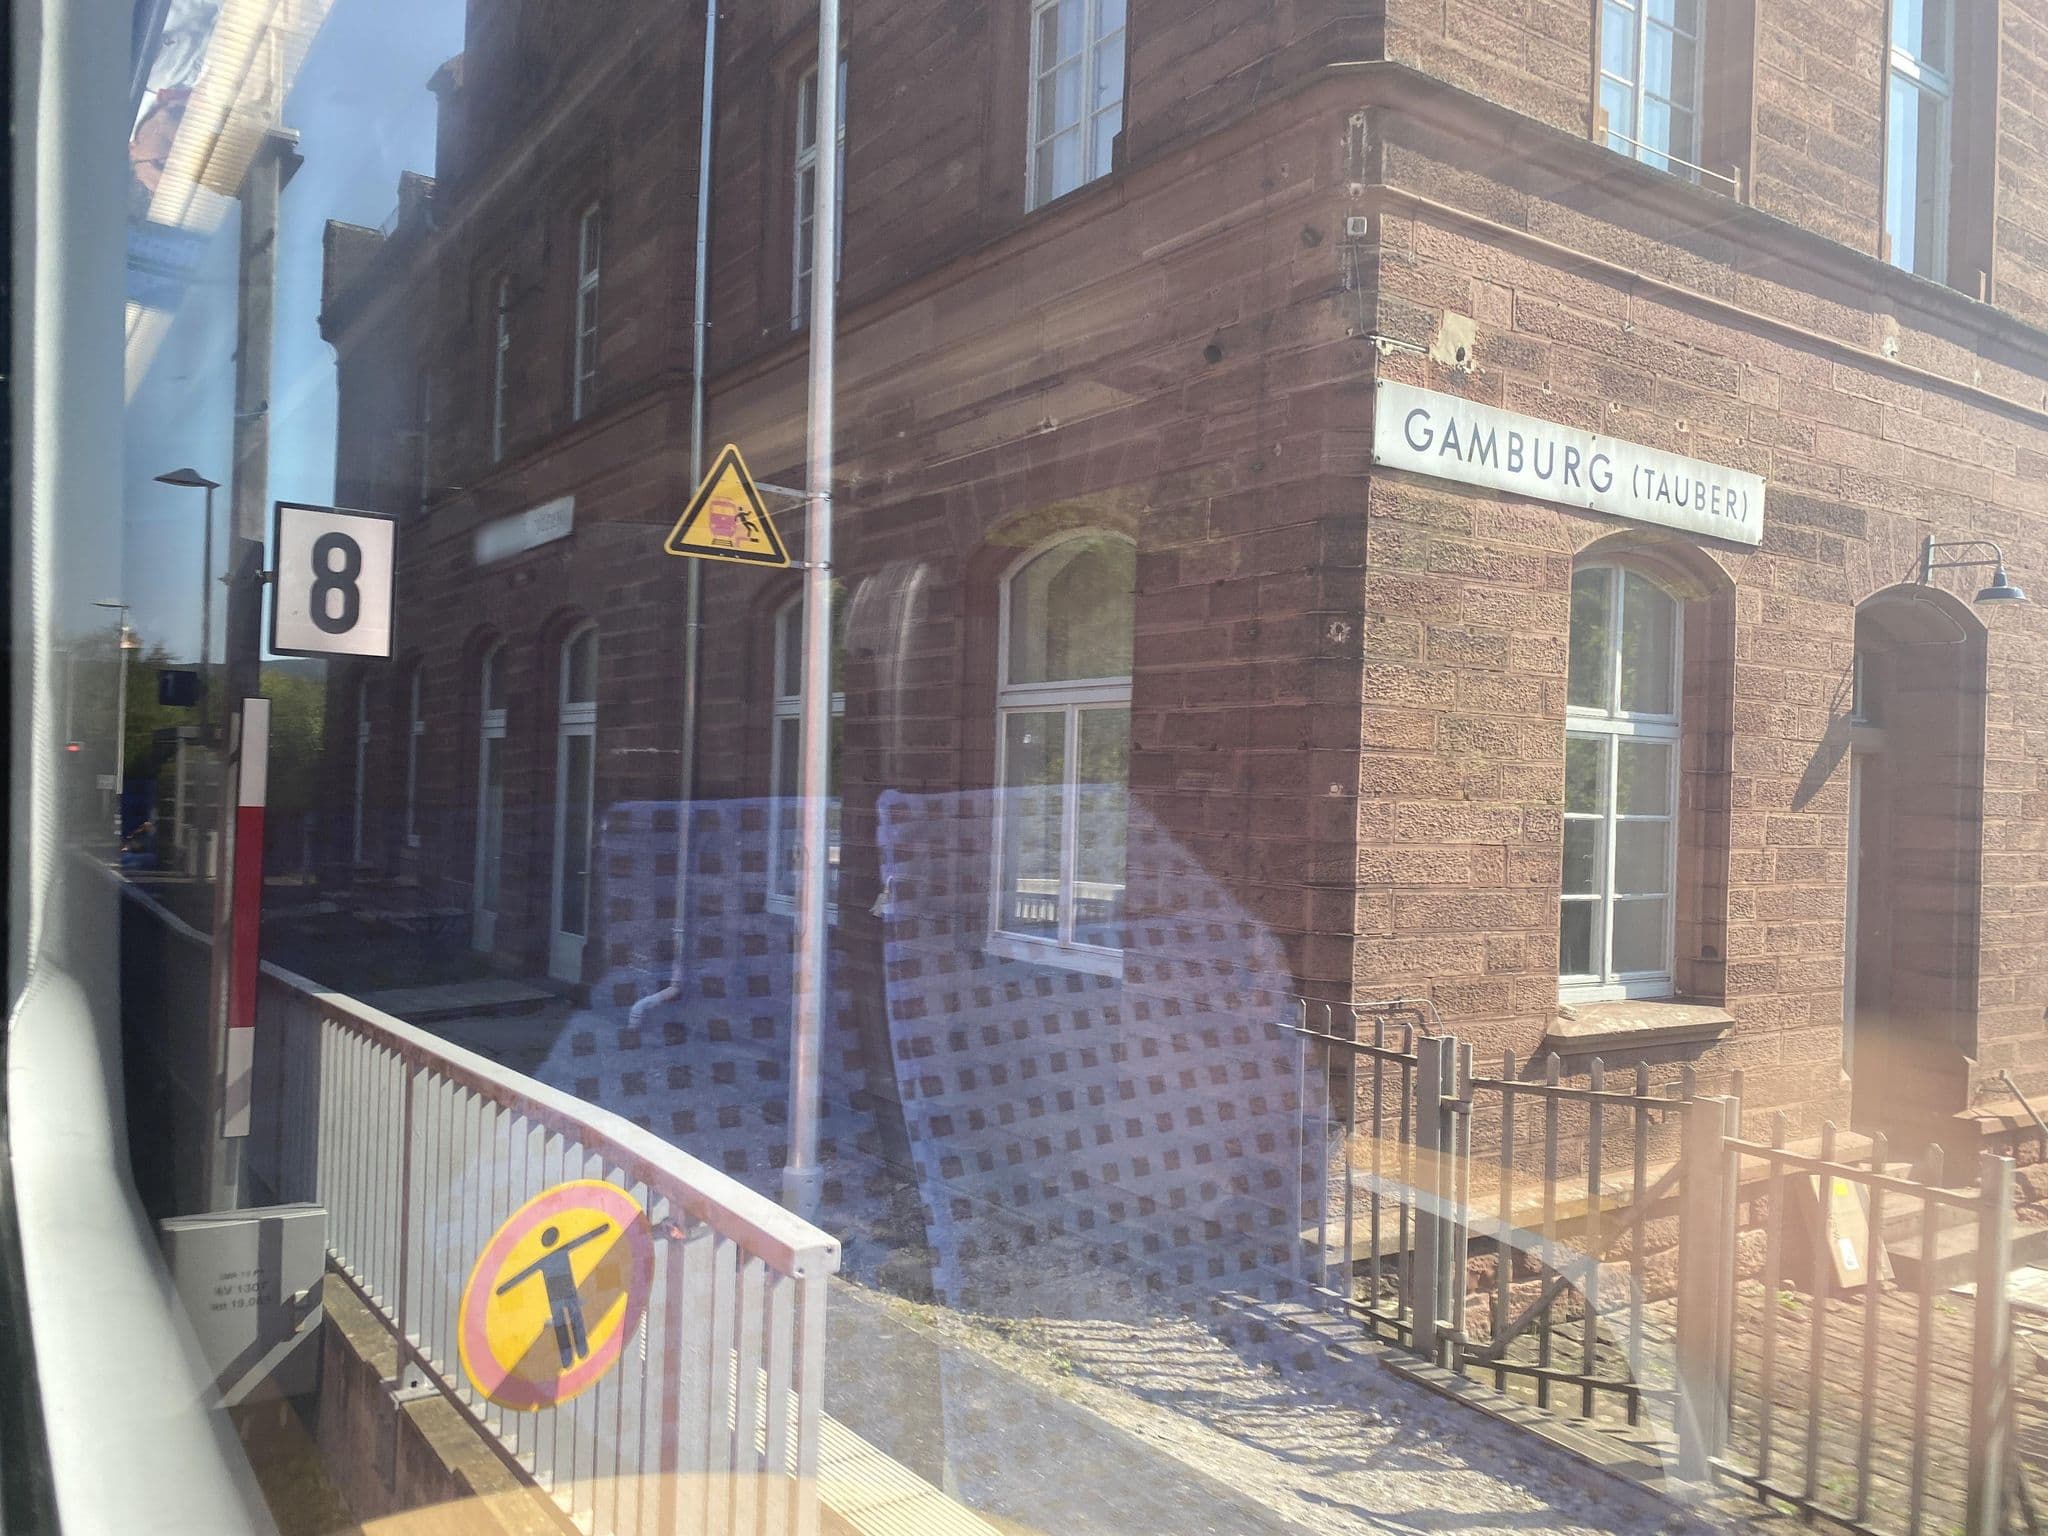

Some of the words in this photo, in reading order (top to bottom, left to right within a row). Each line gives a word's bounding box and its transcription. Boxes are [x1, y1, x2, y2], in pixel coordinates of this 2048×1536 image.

[1404, 408, 1613, 493] GAMBURG
[1632, 464, 1750, 523] (TAUBER)
[310, 531, 362, 635] 8
